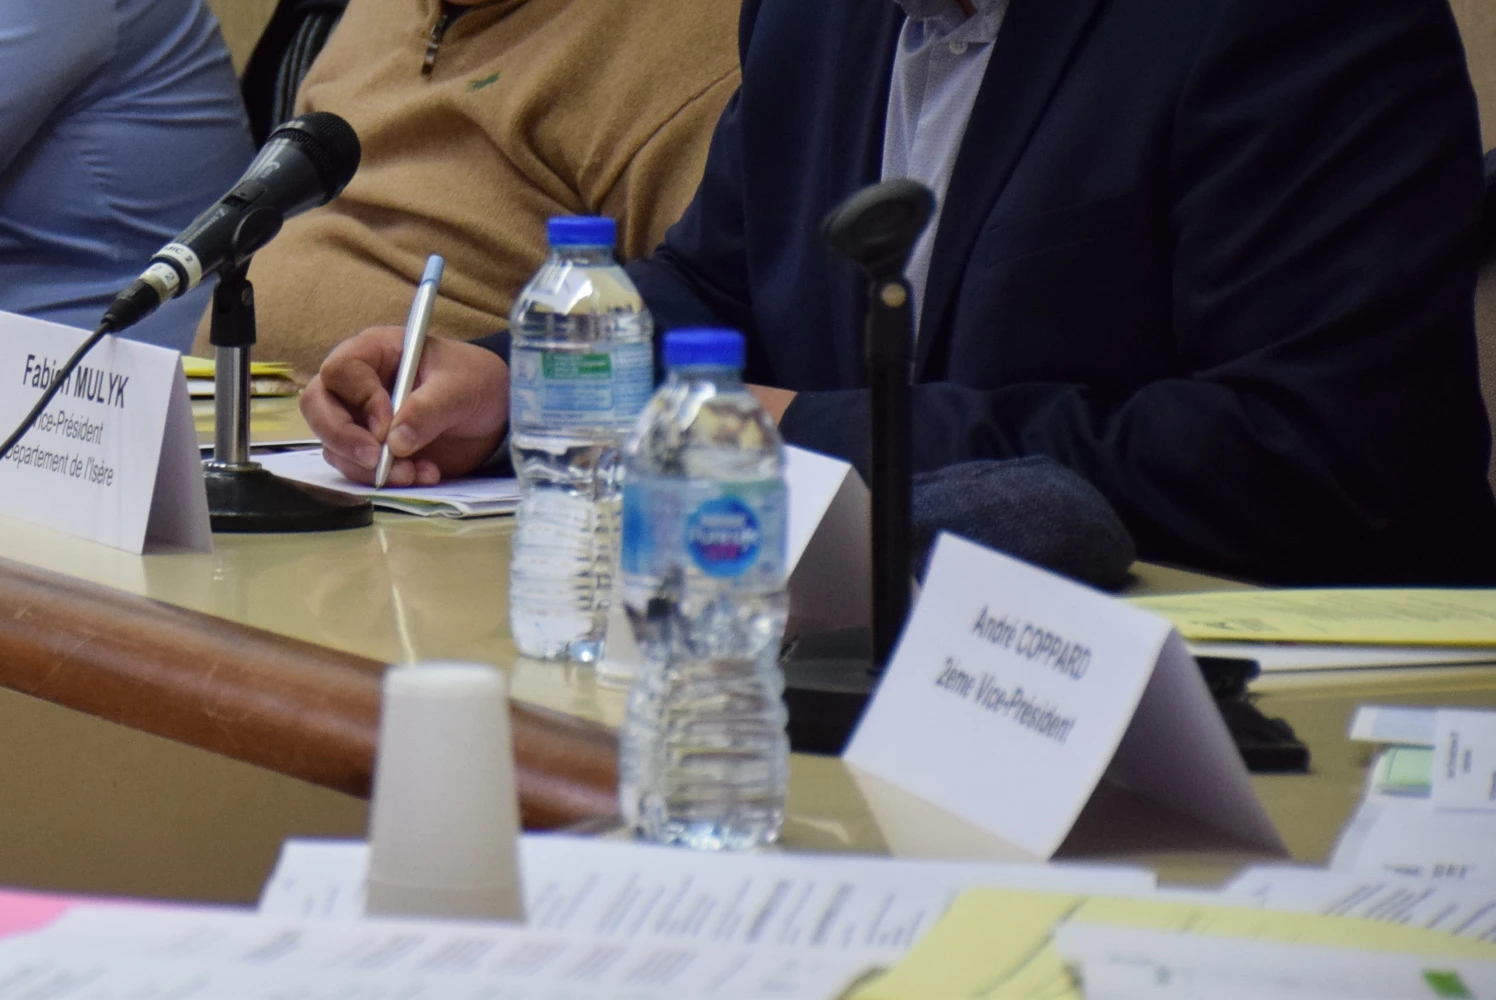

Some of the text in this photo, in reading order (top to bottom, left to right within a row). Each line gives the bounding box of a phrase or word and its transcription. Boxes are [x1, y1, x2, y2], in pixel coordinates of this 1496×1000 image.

[74, 366, 129, 409] MULYK
[31, 410, 104, 445] ice-Président
[69, 453, 84, 478] de
[973, 605, 1092, 681] André COPPARD
[975, 672, 1077, 745] Vice-Président
